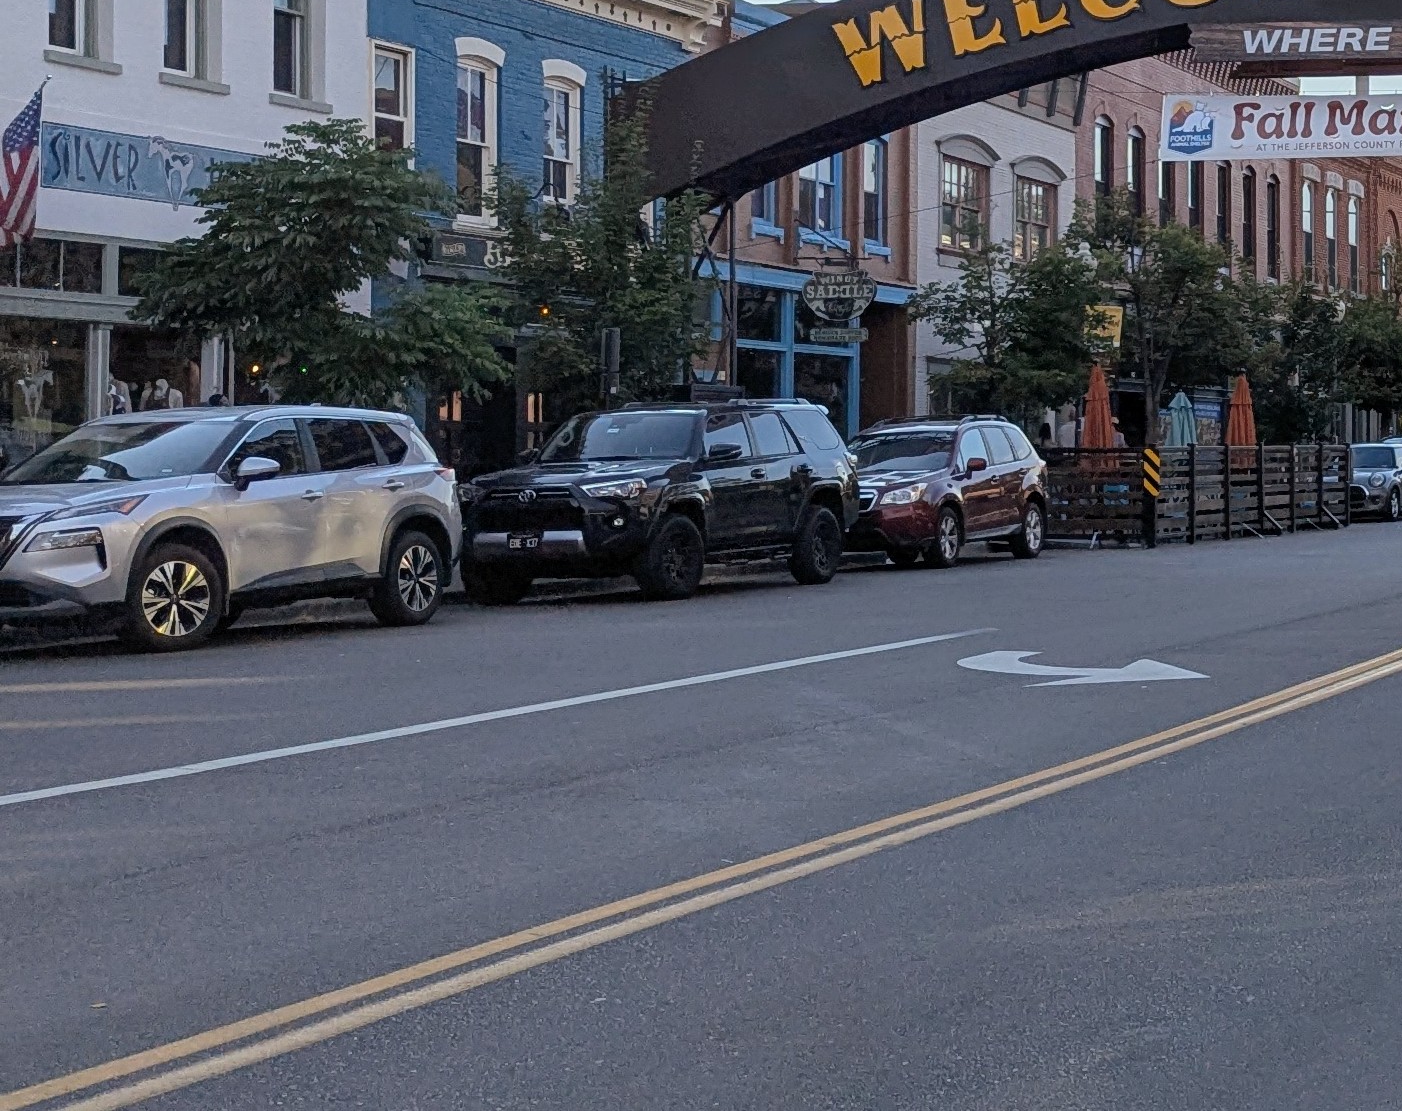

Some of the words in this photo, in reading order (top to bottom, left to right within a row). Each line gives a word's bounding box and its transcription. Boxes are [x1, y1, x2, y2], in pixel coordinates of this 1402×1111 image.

[1243, 26, 1393, 53] WHERE
[1231, 101, 1316, 140] Fall
[1169, 133, 1212, 142] FOOTHILLS
[1271, 143, 1290, 151] THE
[1293, 141, 1350, 151] JEFFERSON
[1353, 140, 1395, 149] COUNTY
